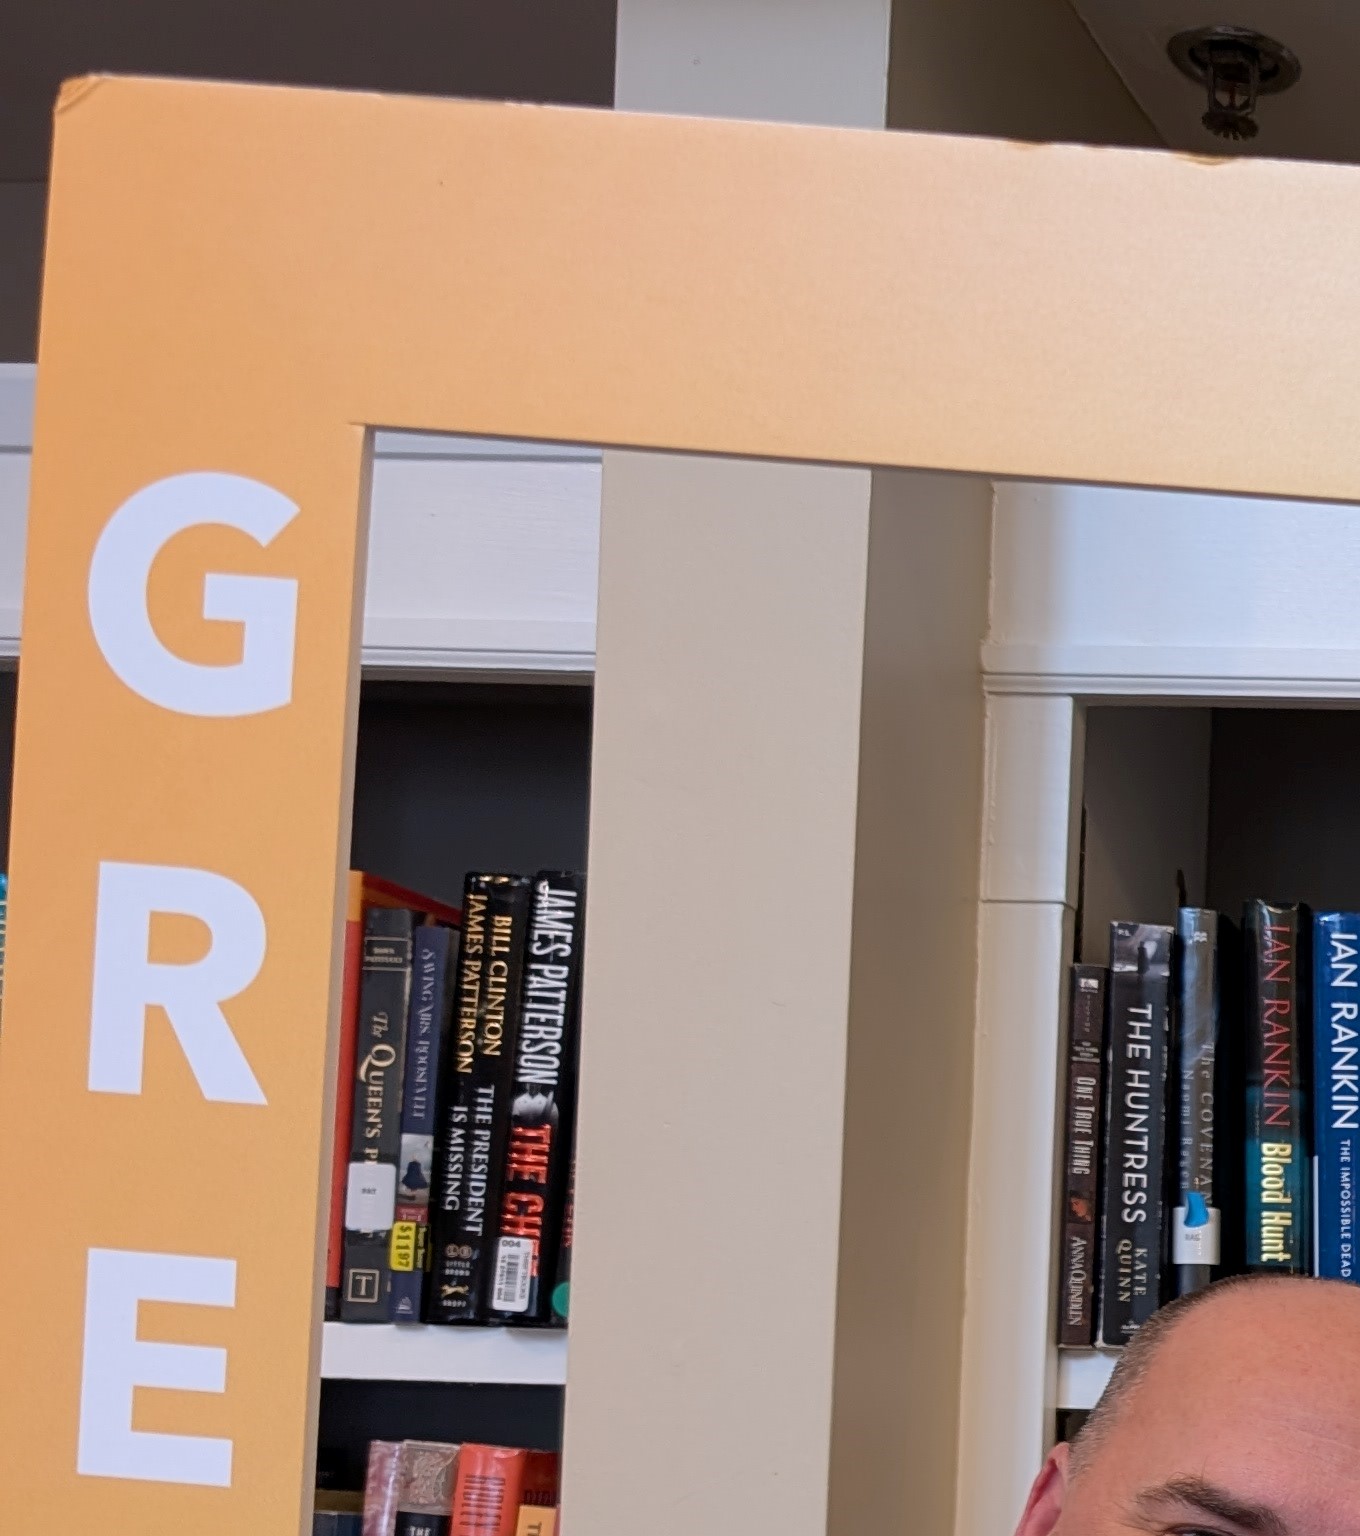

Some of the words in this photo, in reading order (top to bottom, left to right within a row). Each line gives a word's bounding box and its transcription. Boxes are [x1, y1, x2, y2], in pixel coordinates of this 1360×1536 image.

[466, 894, 488, 954] JAMES
[491, 915, 514, 957] BILL
[530, 889, 577, 958] JAMES
[1264, 925, 1290, 982] IAN
[1331, 932, 1358, 988] IAN
[454, 956, 484, 1074] PATTERSON
[483, 960, 510, 1056] CLINTON
[516, 963, 570, 1085] PATTERSON
[1127, 1004, 1152, 1059] THE
[1263, 1000, 1290, 1128] RANKIN
[1331, 1002, 1359, 1129] RANKIN
[475, 1084, 496, 1124] THE
[1122, 1068, 1150, 1224] HUNTRESS
[1261, 1142, 1292, 1203] Blood
[1340, 1139, 1351, 1161] THE
[466, 1127, 492, 1236] PRESIDENT
[1340, 1165, 1352, 1242] IMPOSSIBLE
[1261, 1211, 1292, 1261] Hunt
[1340, 1246, 1351, 1278] DEAD
[1117, 1239, 1131, 1303] QUINN
